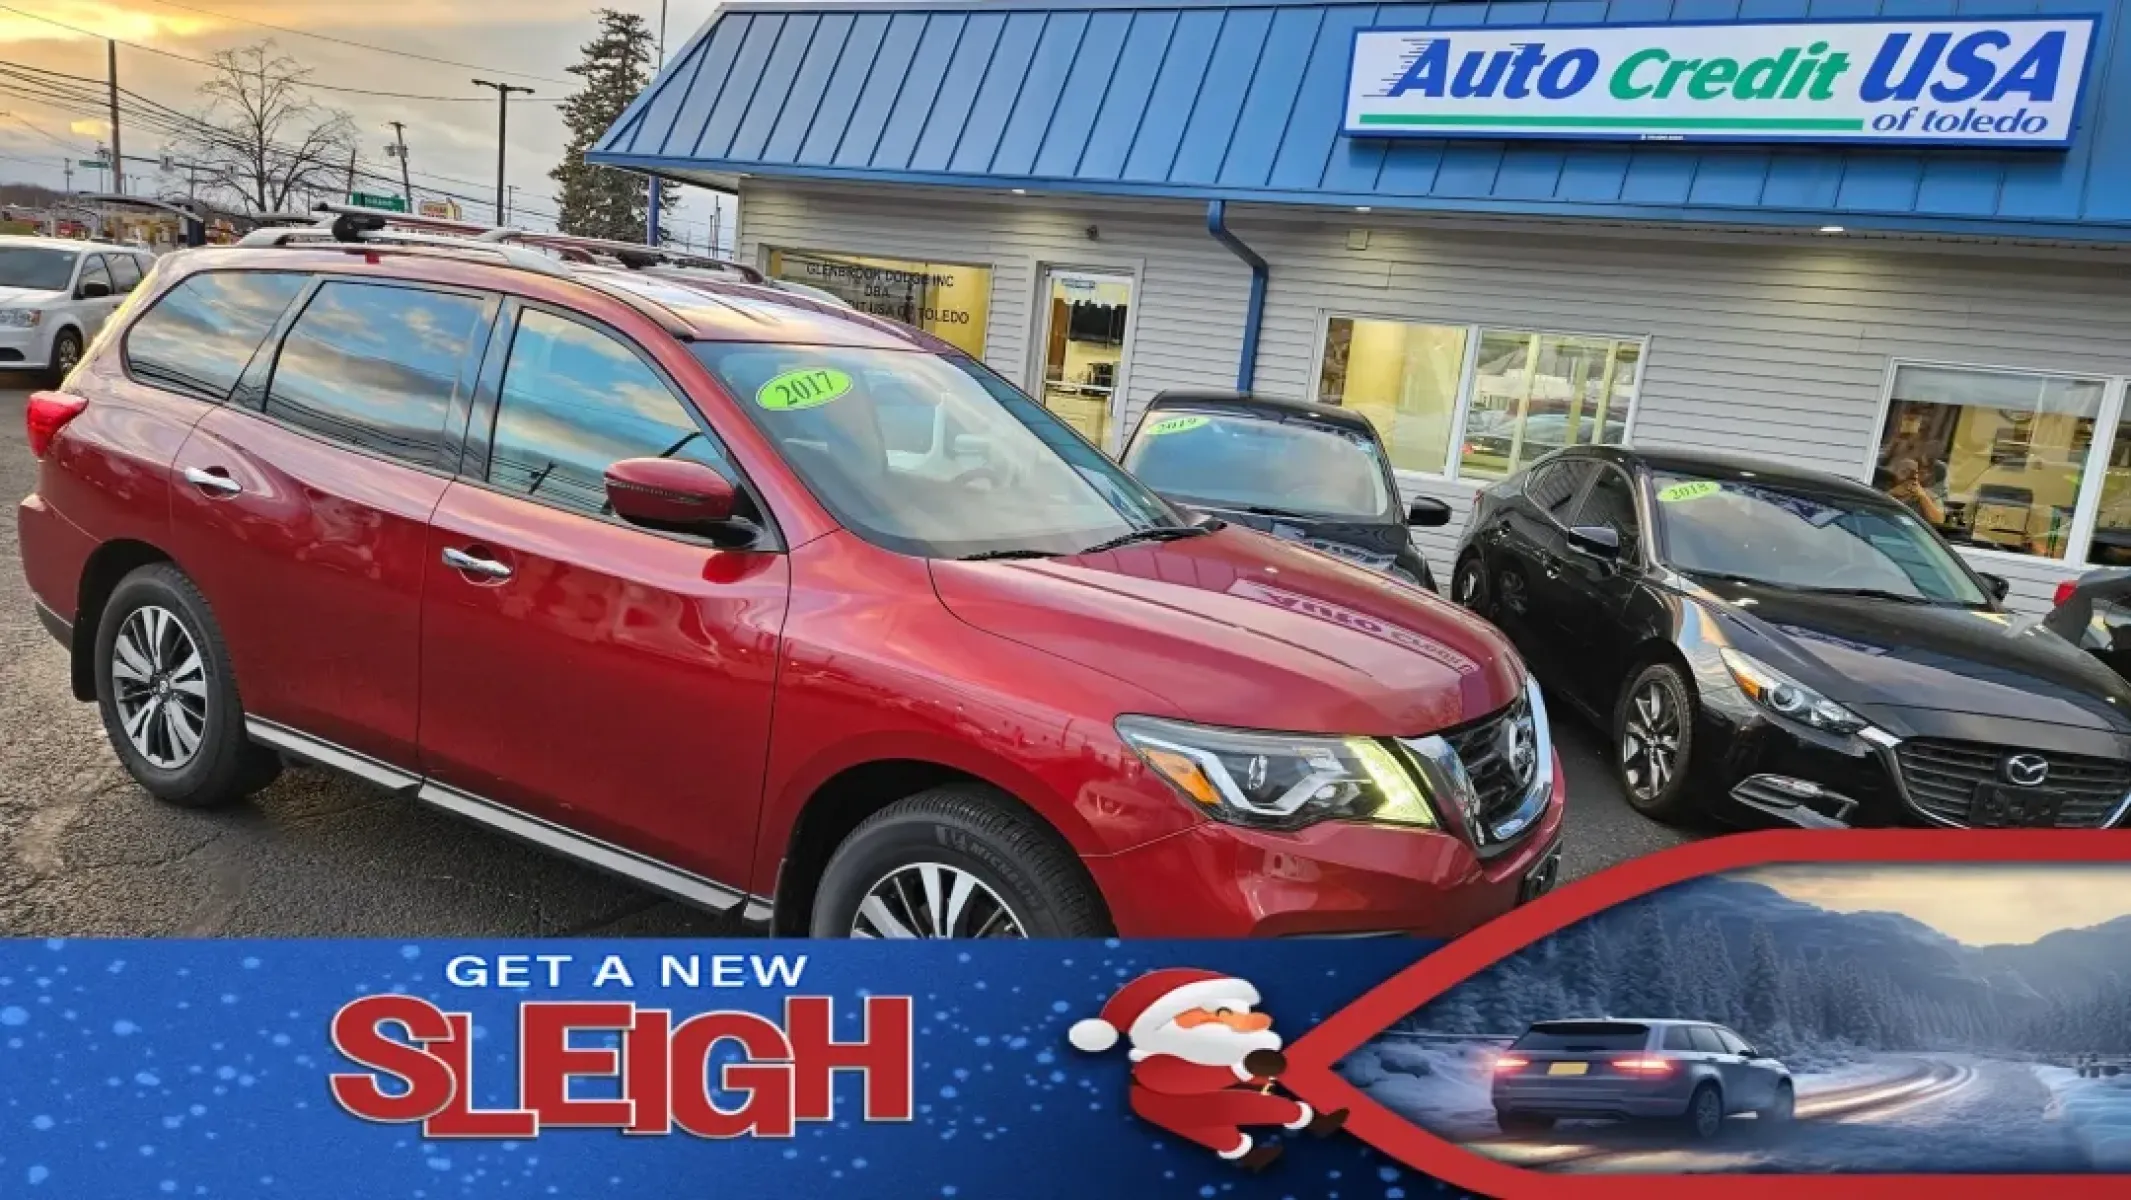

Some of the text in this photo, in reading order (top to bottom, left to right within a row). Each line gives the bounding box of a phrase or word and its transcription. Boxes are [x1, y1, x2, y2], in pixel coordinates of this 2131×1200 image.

[1386, 29, 2067, 103] Auto Credit USA
[1872, 106, 2048, 134] of toledo
[864, 284, 890, 297] DBA
[932, 274, 954, 288] INC
[917, 307, 969, 324] TOLEDO
[775, 371, 833, 405] 2017
